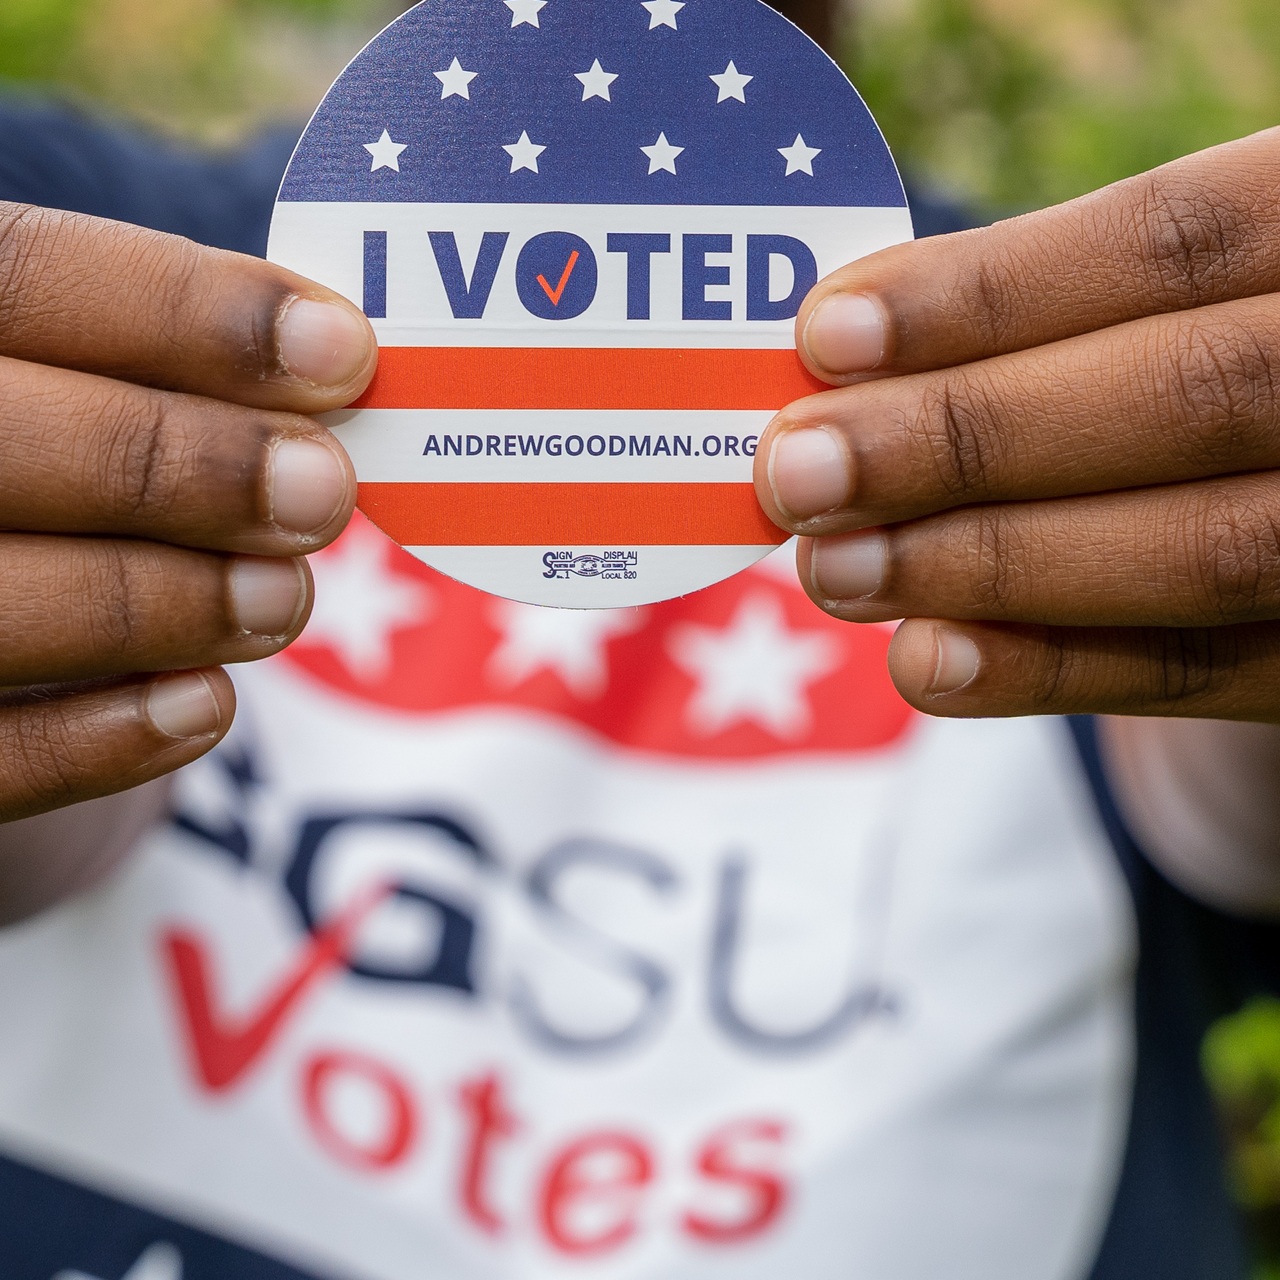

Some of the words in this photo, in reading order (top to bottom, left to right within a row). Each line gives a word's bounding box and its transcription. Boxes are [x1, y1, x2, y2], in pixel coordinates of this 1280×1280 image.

[362, 231, 387, 319] I
[427, 231, 818, 322] VOTED
[421, 434, 758, 457] ANDREWGOODMAN.ORG
[542, 550, 573, 579] SIGN
[603, 551, 638, 565] DISPLAY
[623, 570, 637, 579] 820
[152, 880, 798, 1262] Votes
